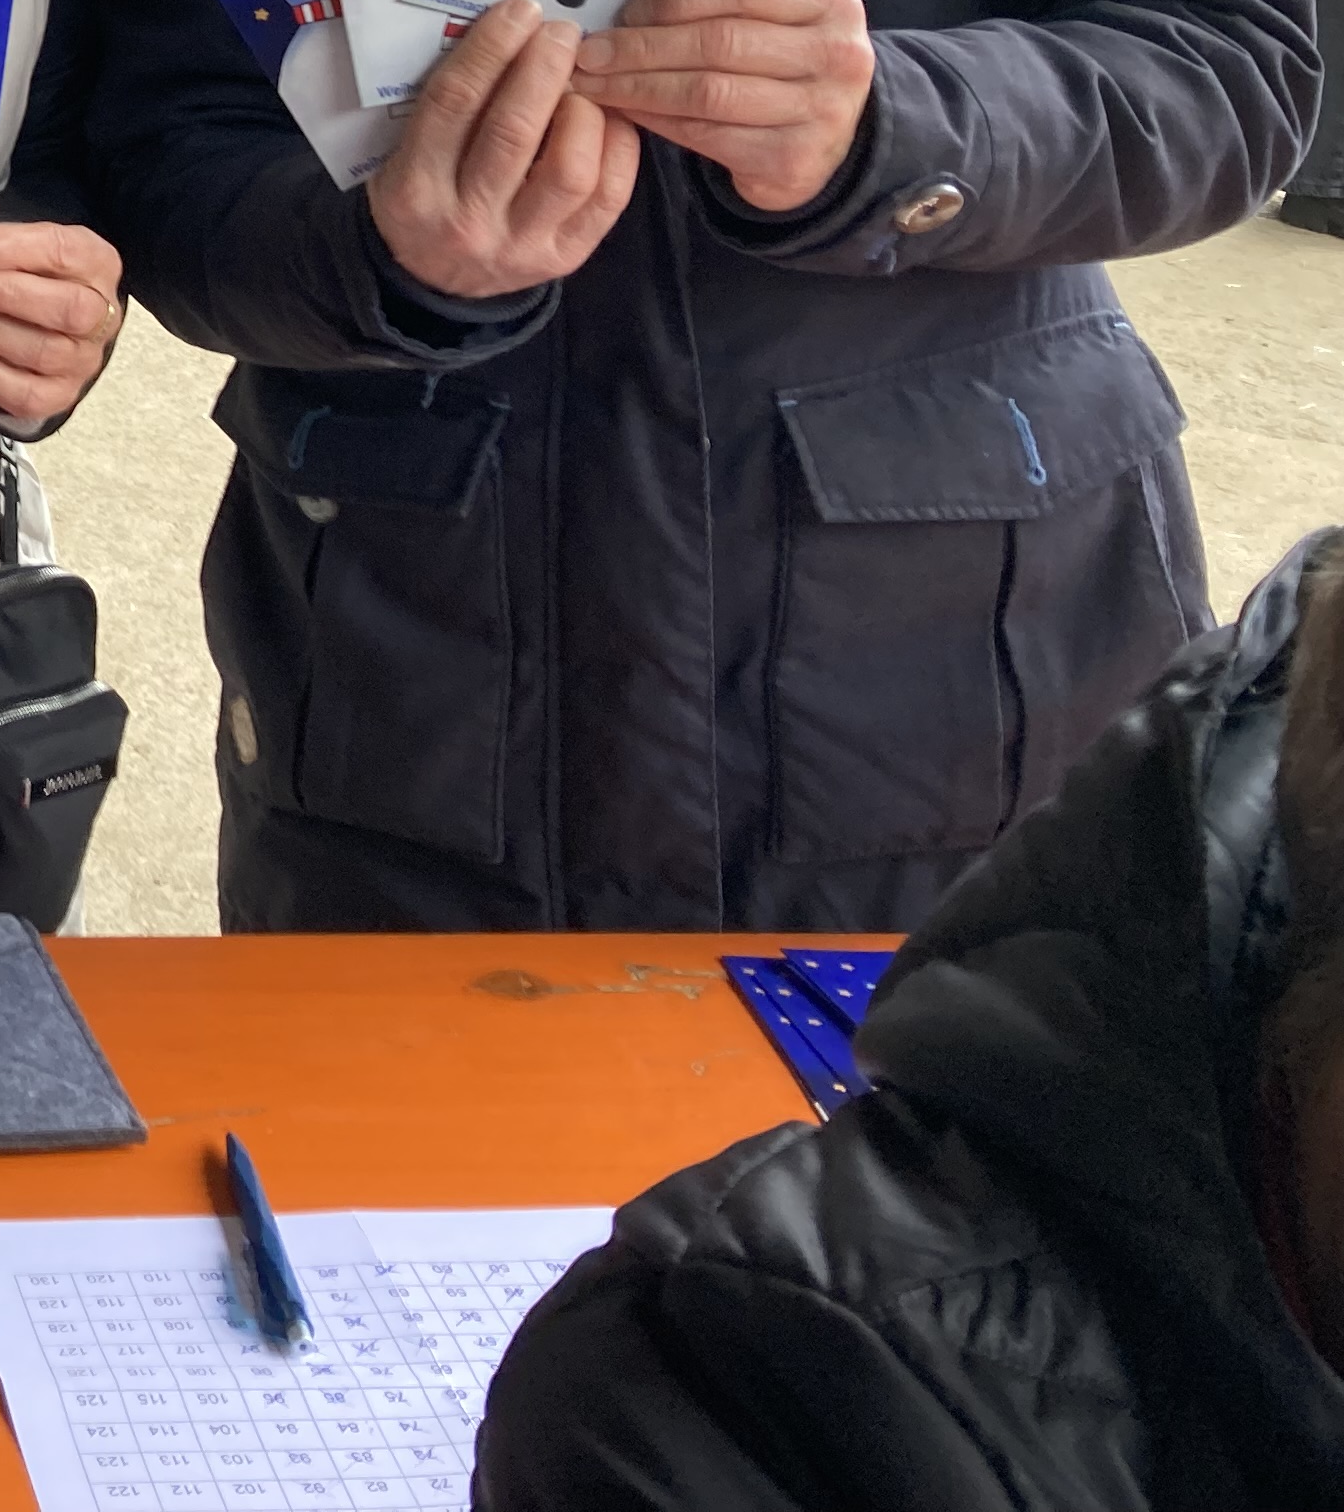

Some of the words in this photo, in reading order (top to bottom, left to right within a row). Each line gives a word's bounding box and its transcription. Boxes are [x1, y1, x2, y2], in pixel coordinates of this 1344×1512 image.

[30, 1276, 59, 1285] 130
[86, 1274, 115, 1284] 120
[143, 1273, 171, 1282] 110
[39, 1299, 67, 1309] 129
[97, 1298, 125, 1307] 119
[154, 1297, 182, 1306] 109
[48, 1324, 76, 1333] 128
[107, 1322, 135, 1332] 118
[164, 1321, 194, 1331] 108
[59, 1347, 87, 1356] 127
[119, 1346, 145, 1356] 117
[176, 1346, 204, 1355] 107
[77, 1395, 107, 1406] 125
[137, 1394, 167, 1405] 115
[197, 1393, 228, 1404] 105
[87, 1426, 117, 1437] 124
[148, 1426, 178, 1437] 114
[209, 1424, 241, 1436] 104
[276, 1423, 298, 1434] 94
[96, 1456, 128, 1467] 123
[159, 1455, 190, 1466] 113
[220, 1454, 253, 1465] 103
[107, 1486, 140, 1497] 122
[171, 1484, 202, 1495] 112
[233, 1483, 266, 1494] 102
[367, 1481, 388, 1492] 82
